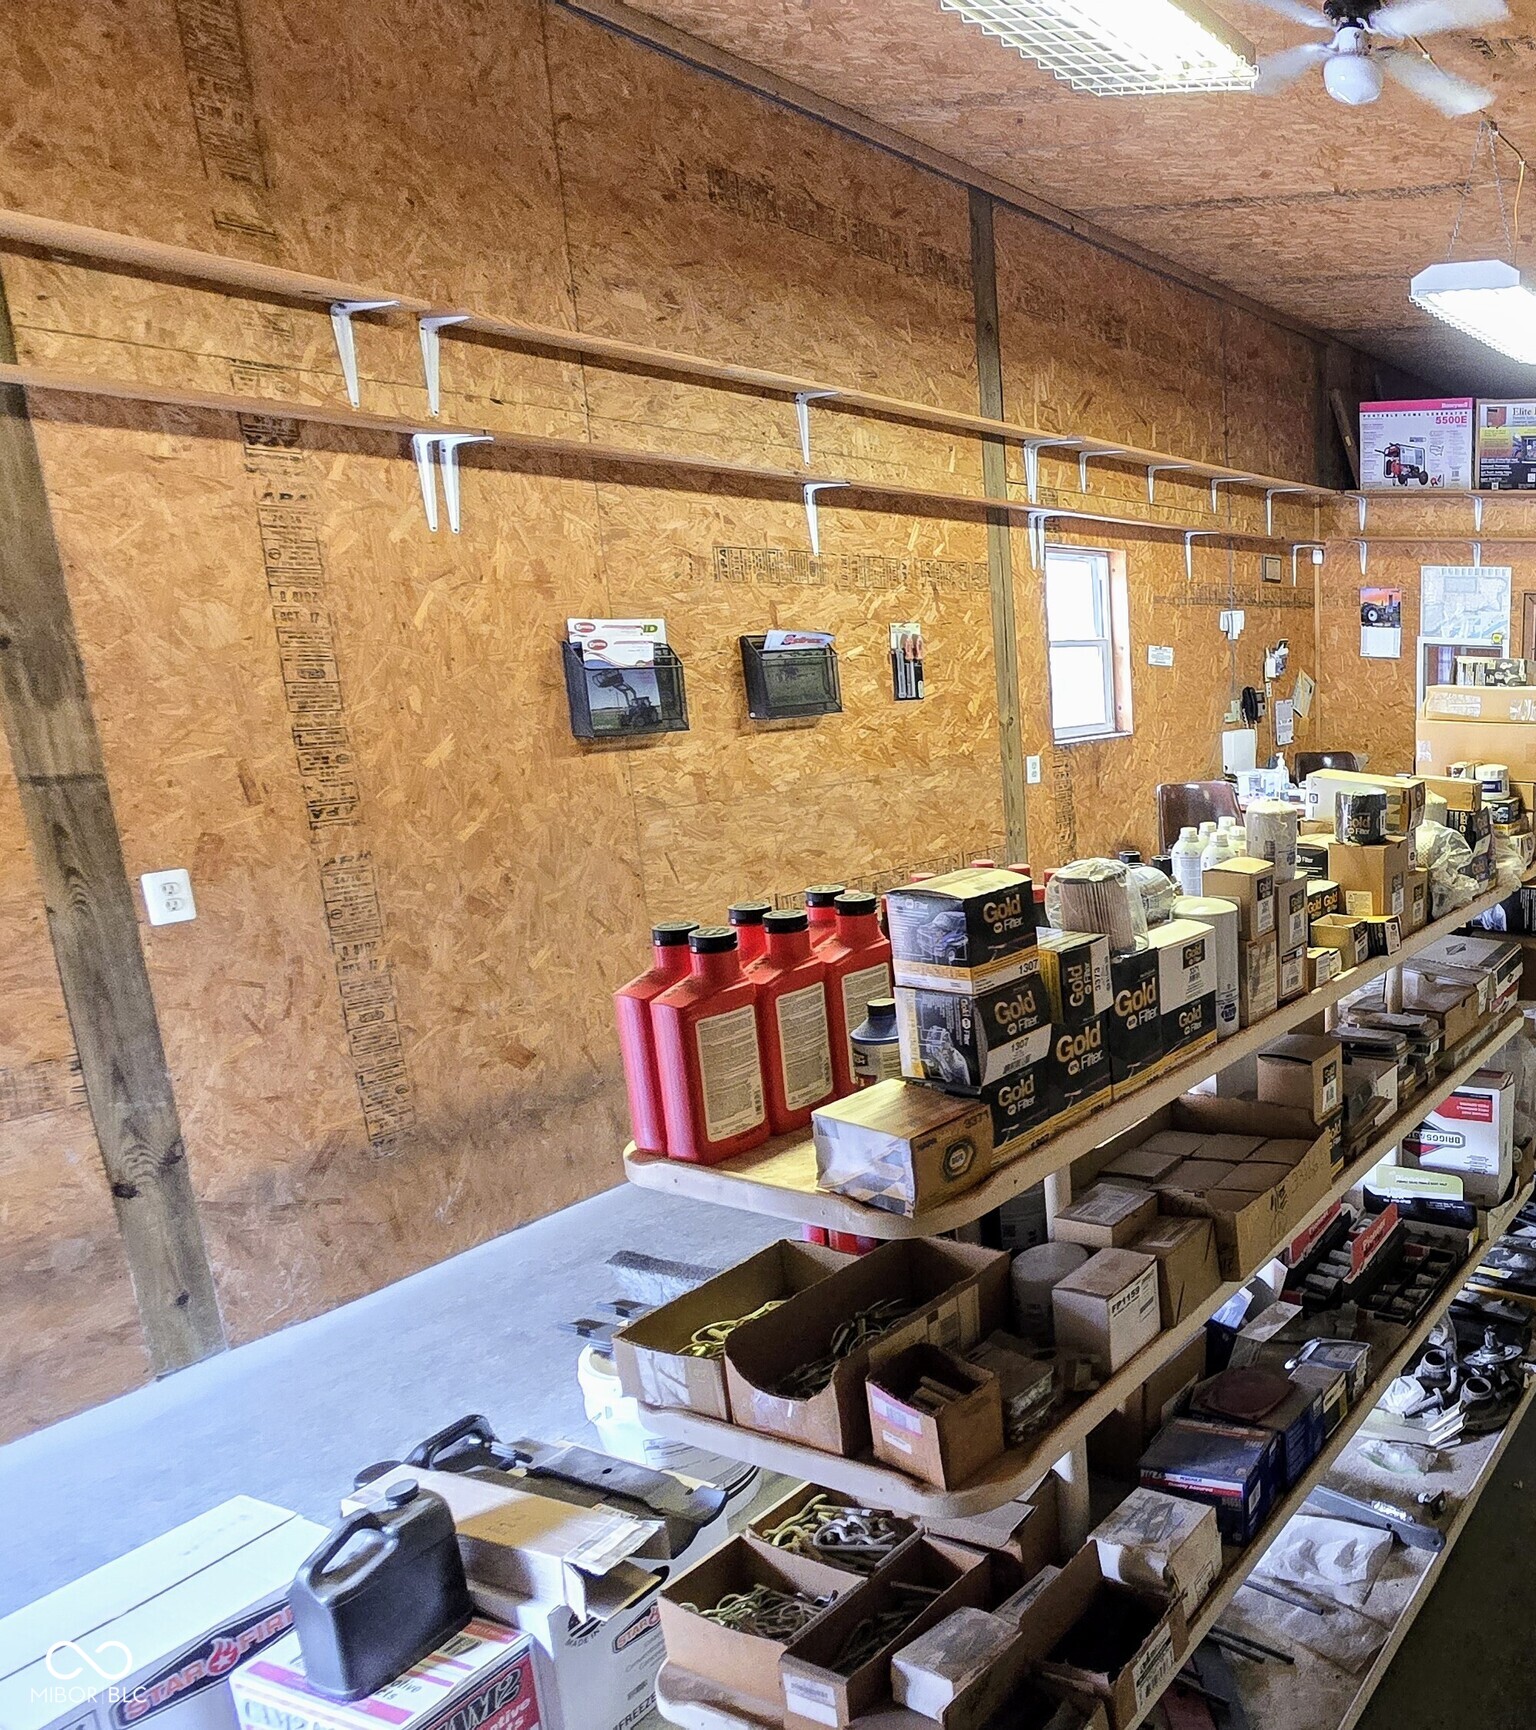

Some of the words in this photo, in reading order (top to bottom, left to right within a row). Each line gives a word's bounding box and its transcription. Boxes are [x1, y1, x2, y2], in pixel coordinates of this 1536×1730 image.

[1435, 415, 1468, 425] 5500E
[1513, 407, 1532, 416] Elite
[1301, 856, 1314, 864] Filter
[983, 893, 1022, 922] Gold
[1308, 898, 1322, 914] Gold
[1324, 891, 1338, 907] Gold
[1003, 916, 1024, 931] Filter
[1018, 959, 1040, 975] 1307
[1068, 964, 1085, 1007] Gold
[1114, 976, 1157, 1018] Gold
[994, 990, 1037, 1025] Gold
[1138, 1006, 1160, 1026] Filter
[1178, 1004, 1203, 1028] Gold
[1018, 1015, 1039, 1032] Filter
[1010, 1037, 1030, 1052] 1307
[1056, 1020, 1101, 1063] Gold
[1080, 1050, 1104, 1070] Filter
[998, 1073, 1036, 1108] Gold
[1017, 1094, 1036, 1113] Filter
[1426, 1132, 1461, 1144] BRIGGS
[617, 1618, 648, 1647] STAR
[565, 1637, 589, 1648] MADE
[124, 1657, 207, 1721] STAR
